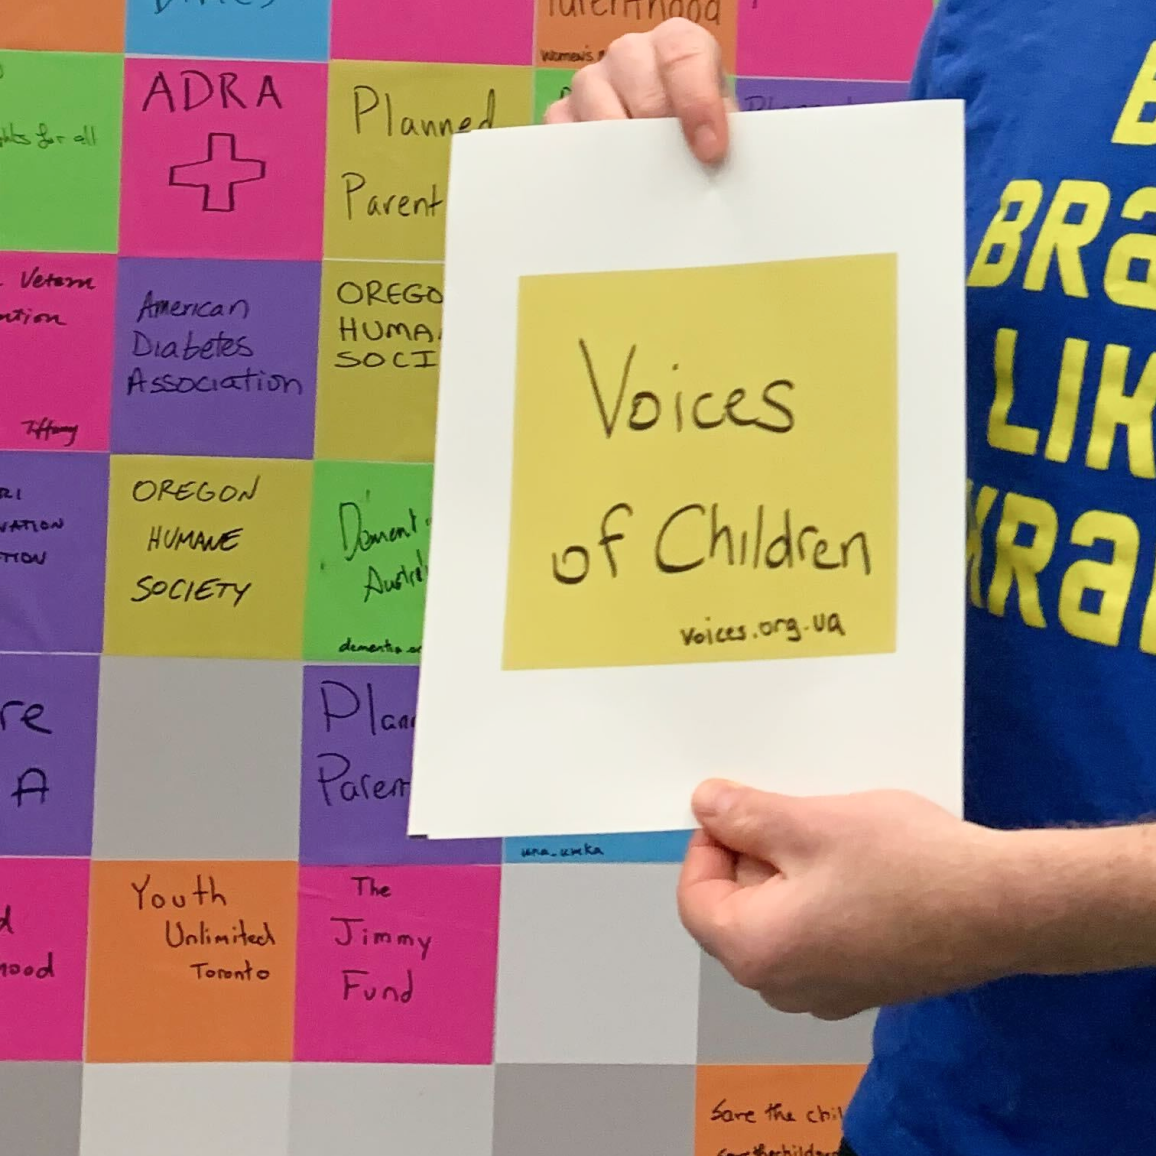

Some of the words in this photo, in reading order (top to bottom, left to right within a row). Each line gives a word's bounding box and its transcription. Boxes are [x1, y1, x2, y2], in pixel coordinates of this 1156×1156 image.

[142, 69, 282, 113] ADRA
[340, 171, 443, 221] Parent
[136, 290, 251, 323] American
[336, 280, 443, 305] OREGO
[339, 316, 443, 342] HUMA
[132, 330, 255, 360] Diabetes
[334, 349, 438, 369] SOCI
[126, 368, 303, 397] Association
[578, 338, 795, 439] Voices
[132, 475, 261, 503] OREGON
[147, 525, 244, 552] HUMANE
[552, 502, 634, 585] of
[655, 502, 872, 577] Children
[131, 575, 252, 608] SOCIETY
[131, 873, 228, 911] Youth
[350, 875, 392, 898] The
[165, 918, 276, 949] Unlimited
[330, 916, 432, 961] Jimmy
[189, 959, 270, 982] Toronto
[342, 969, 413, 1004] Fund
[805, 1104, 843, 1124] chil
